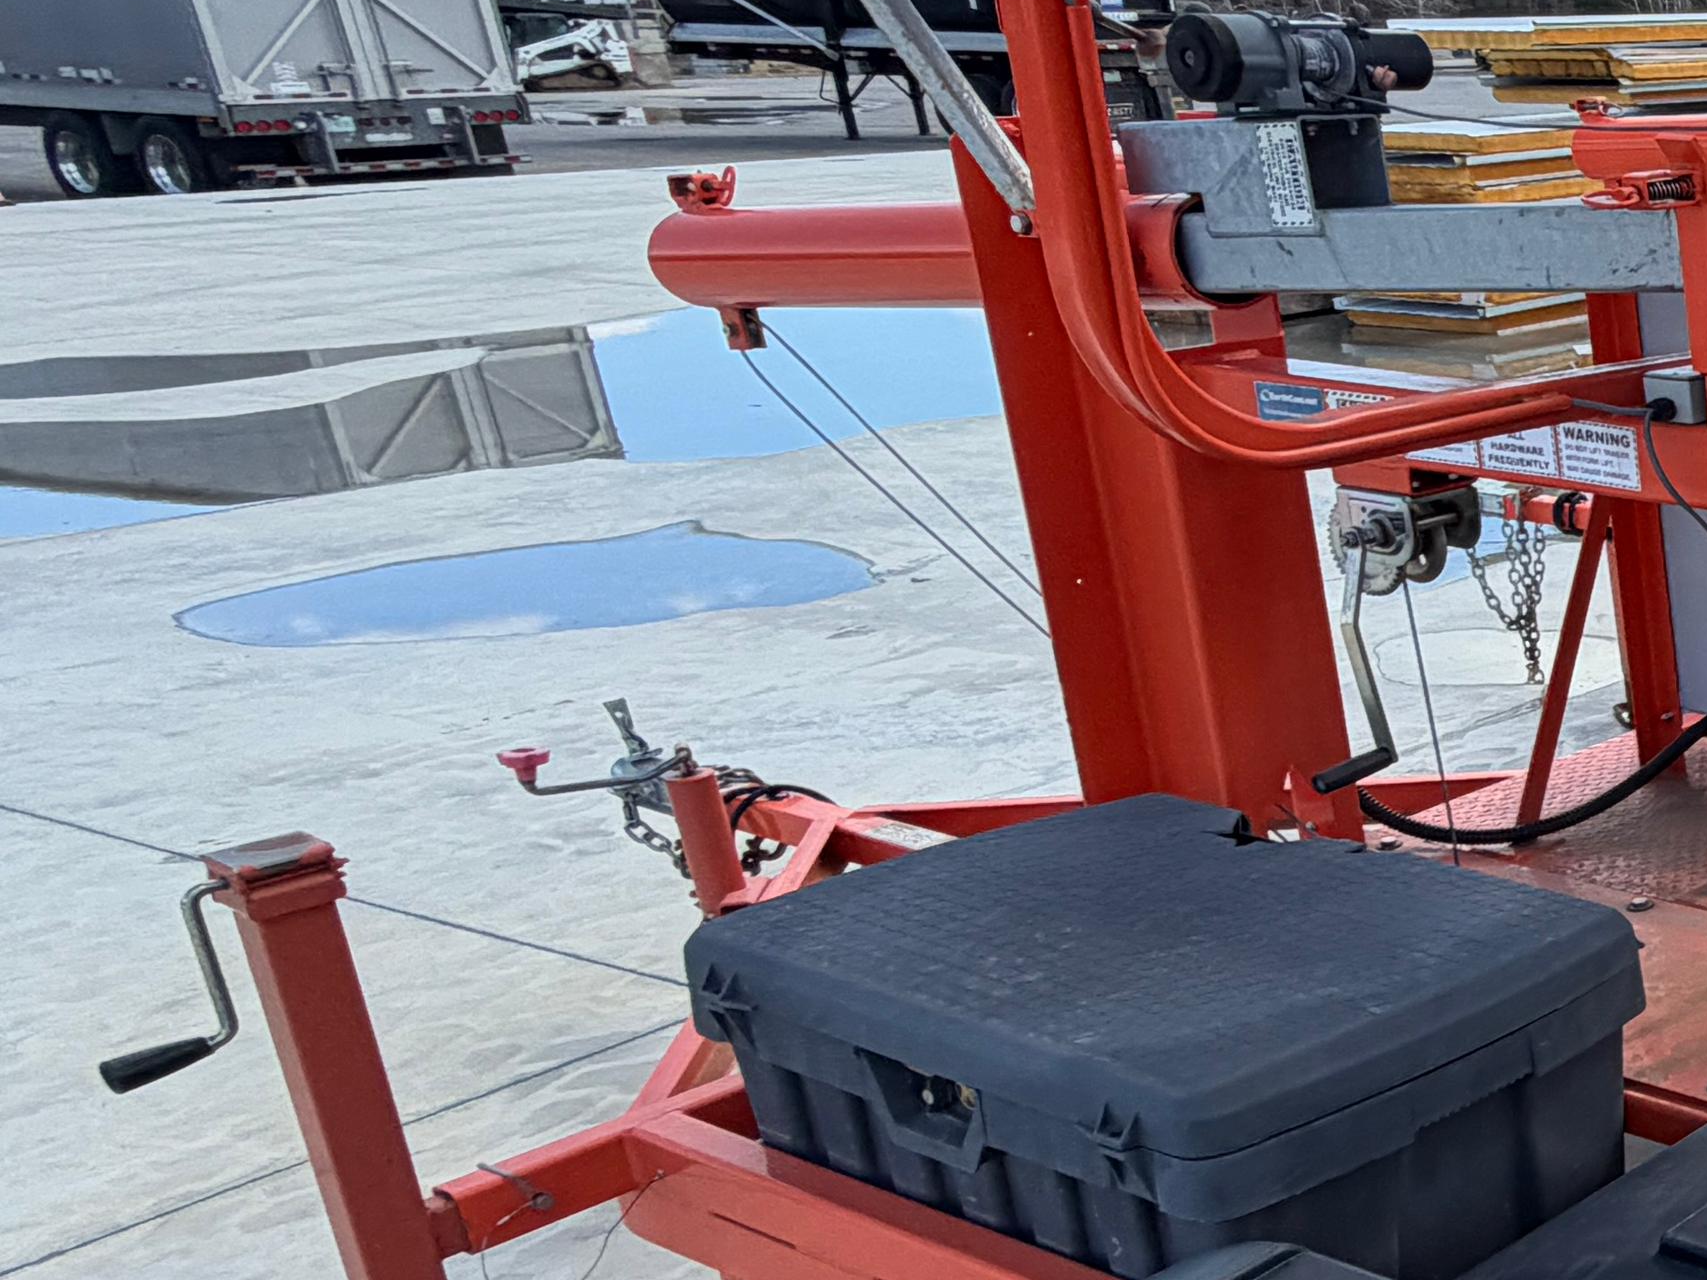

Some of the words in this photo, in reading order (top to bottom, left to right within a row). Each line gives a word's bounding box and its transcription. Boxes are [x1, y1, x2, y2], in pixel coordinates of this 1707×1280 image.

[1563, 426, 1631, 449] WARNING
[1490, 441, 1545, 457] HARDWARE
[1489, 454, 1550, 470] FREQUENTLY
